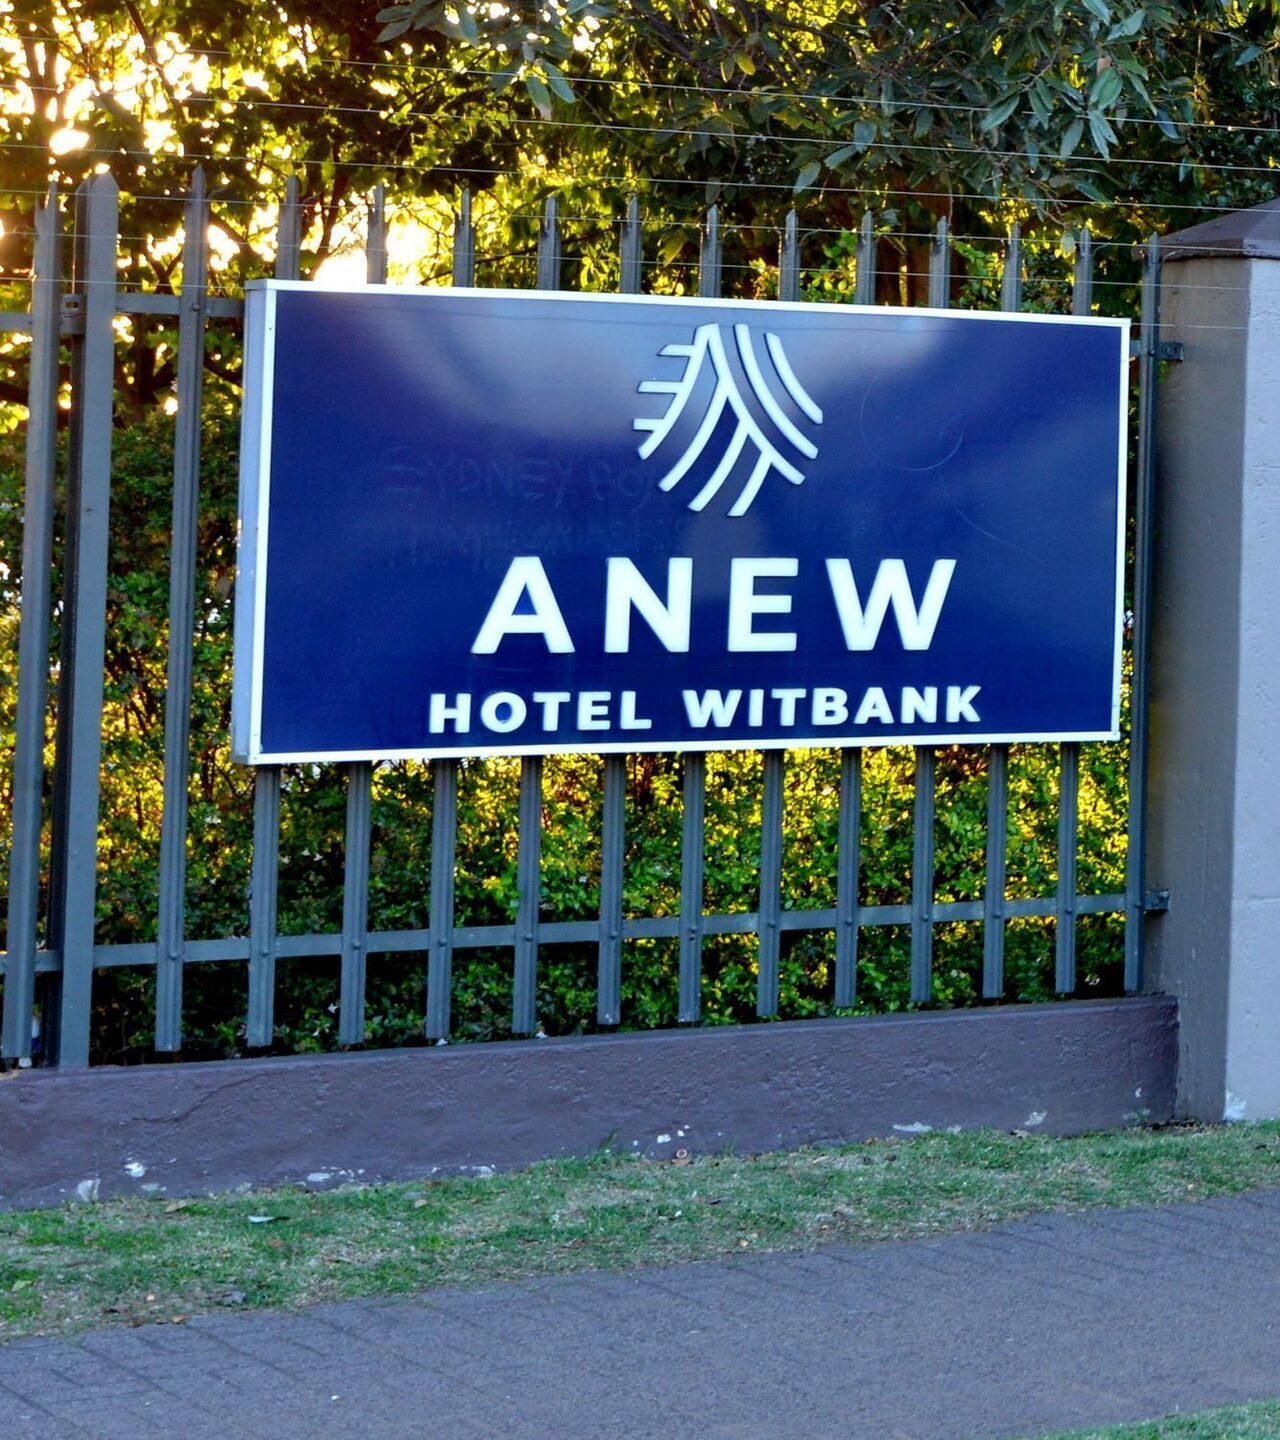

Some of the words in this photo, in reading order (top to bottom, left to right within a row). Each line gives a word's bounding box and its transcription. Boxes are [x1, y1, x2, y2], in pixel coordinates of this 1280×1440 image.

[470, 556, 958, 654] ANEW
[429, 690, 653, 734] HOTEL
[683, 685, 982, 728] WITBANK
